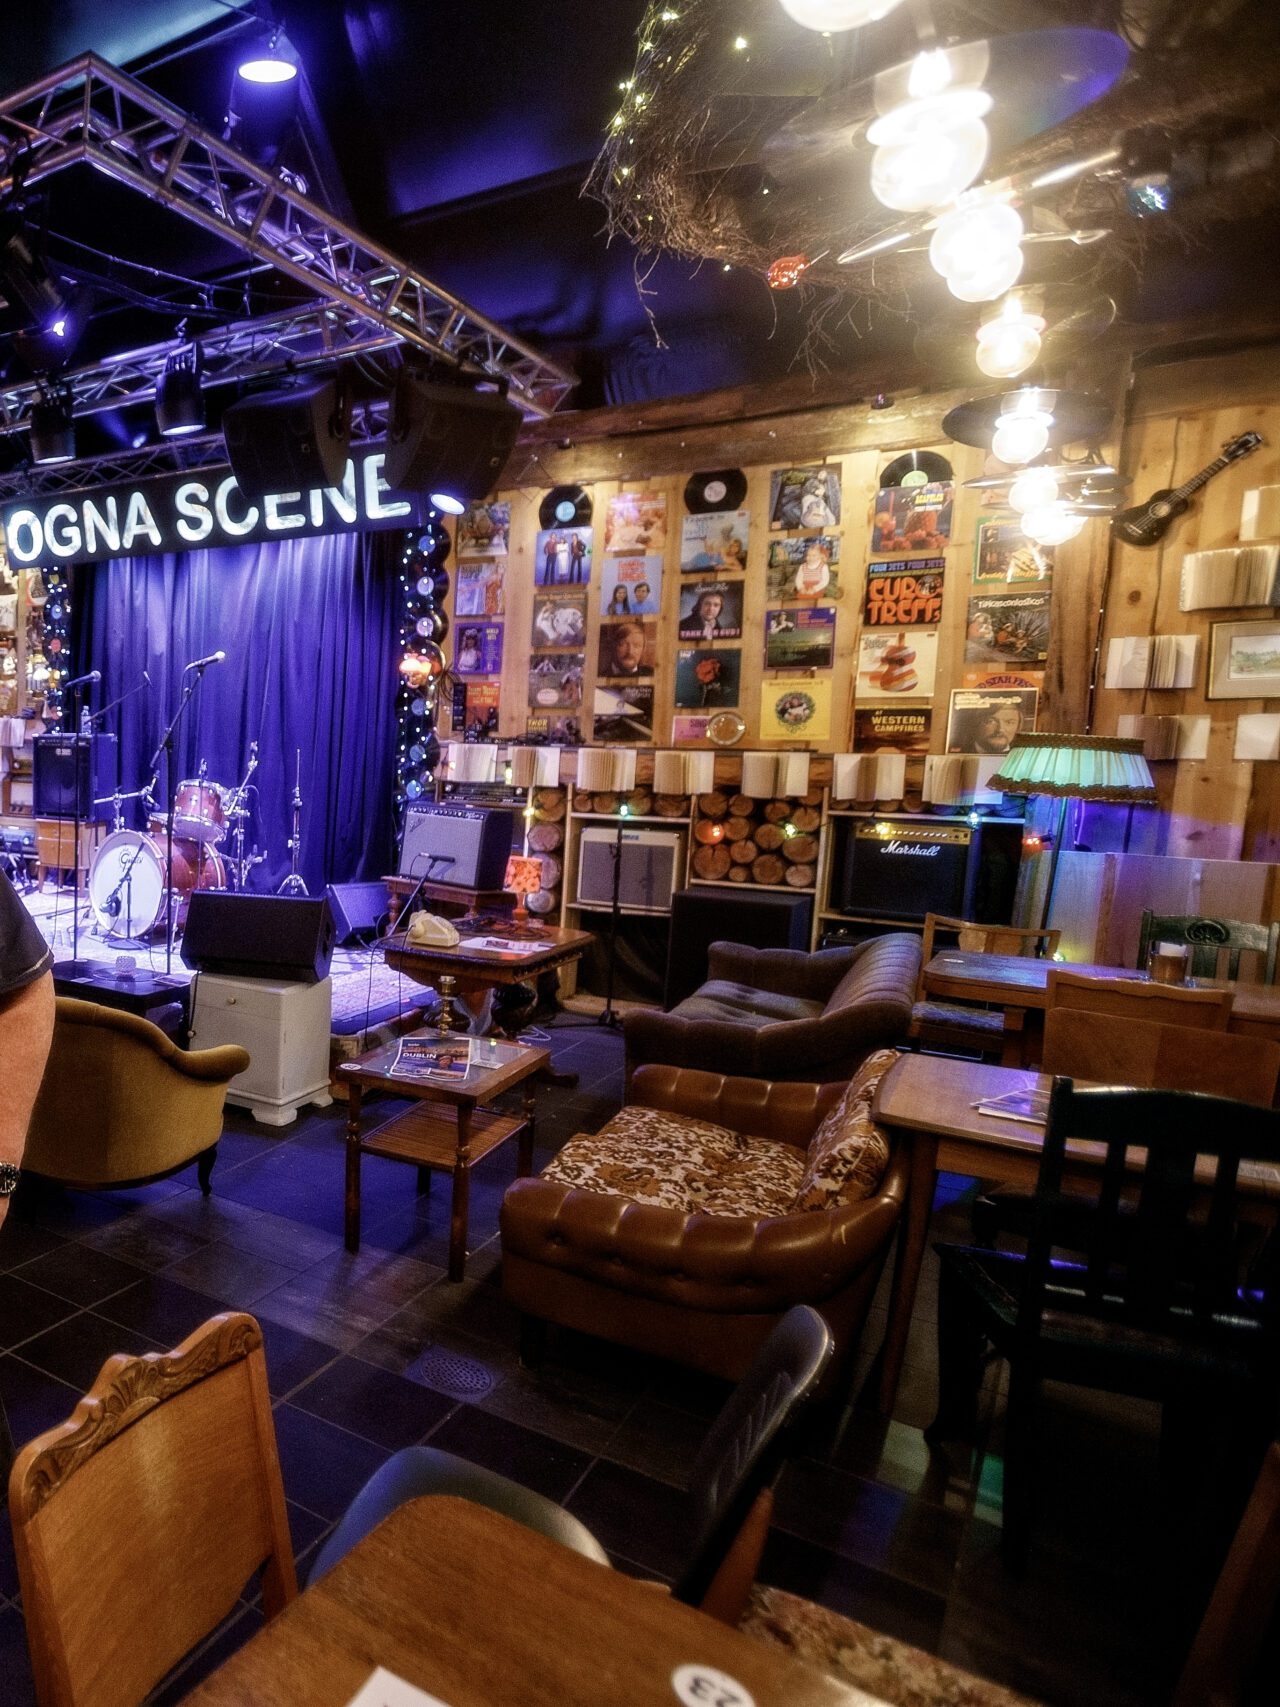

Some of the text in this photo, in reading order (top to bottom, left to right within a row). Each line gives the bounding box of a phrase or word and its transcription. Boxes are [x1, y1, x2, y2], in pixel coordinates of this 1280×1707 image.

[7, 454, 411, 562] OGNA SCENE
[872, 715, 925, 725] WESTERN
[874, 724, 925, 732] CAMPFIRES
[880, 839, 941, 857] Marshall
[402, 1052, 437, 1060] DUBLIN
